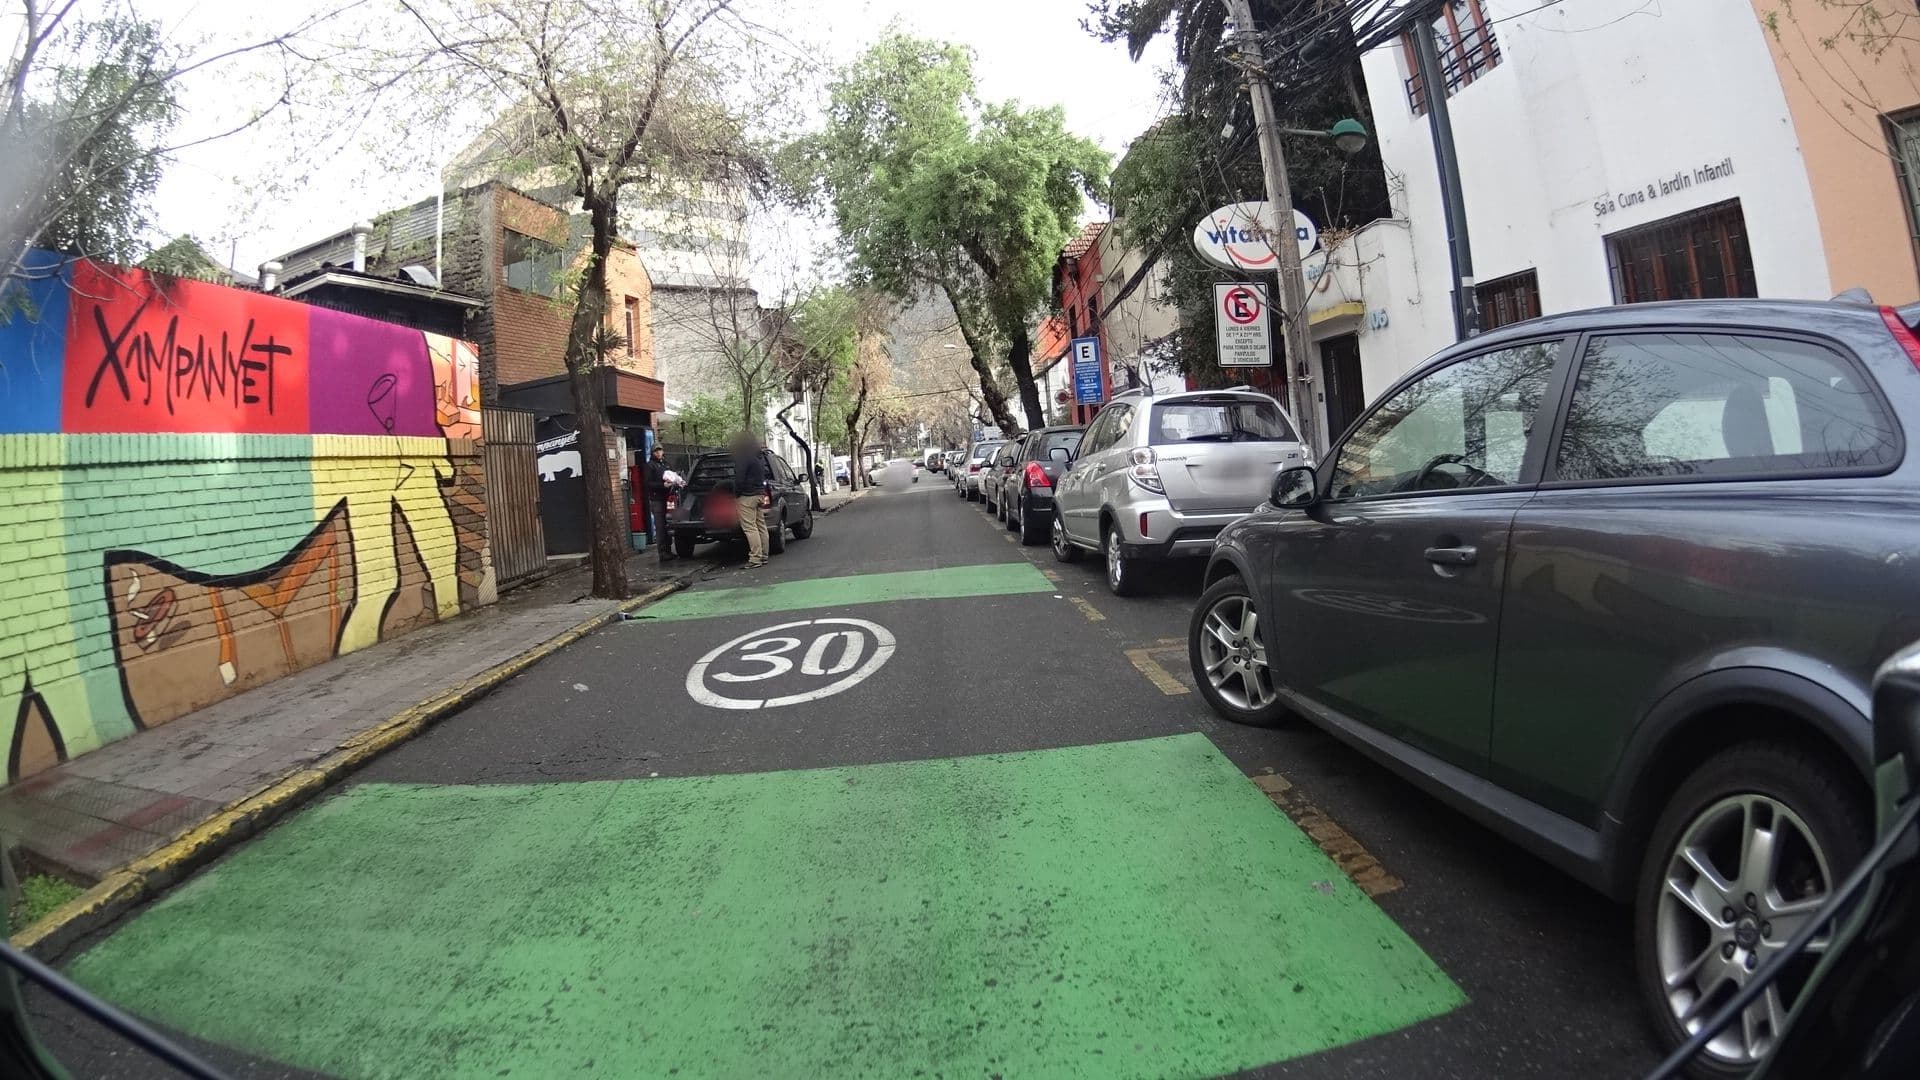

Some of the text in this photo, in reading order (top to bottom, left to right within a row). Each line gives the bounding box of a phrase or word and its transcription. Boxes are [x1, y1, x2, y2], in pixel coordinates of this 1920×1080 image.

[1618, 190, 1645, 208] Cuna
[1647, 184, 1657, 199] &
[1693, 157, 1736, 185] Infantil
[1081, 346, 1090, 358] E
[712, 631, 865, 683] 30
